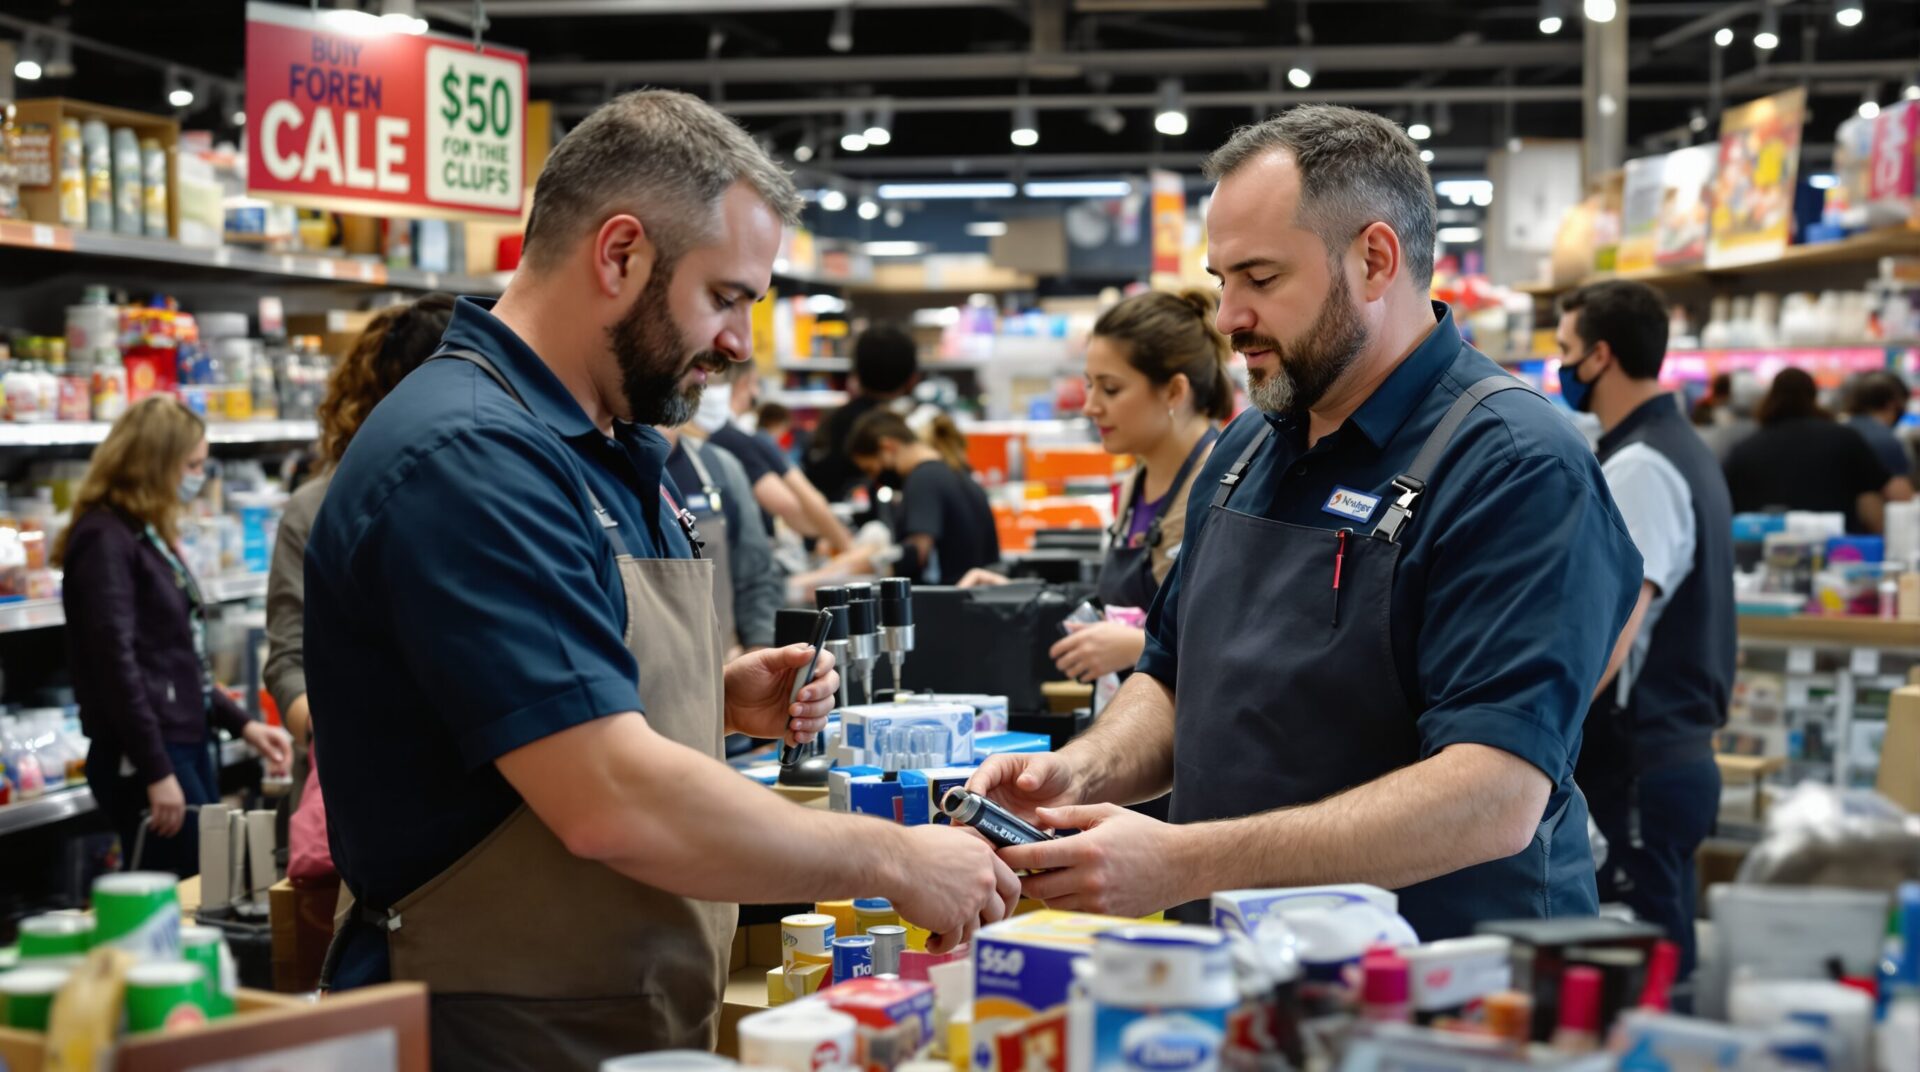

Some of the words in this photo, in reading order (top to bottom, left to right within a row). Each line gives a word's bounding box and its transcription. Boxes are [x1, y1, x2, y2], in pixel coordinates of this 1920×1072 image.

[289, 64, 382, 110] FOREN
[441, 64, 511, 138] $50
[260, 100, 410, 193] CALE
